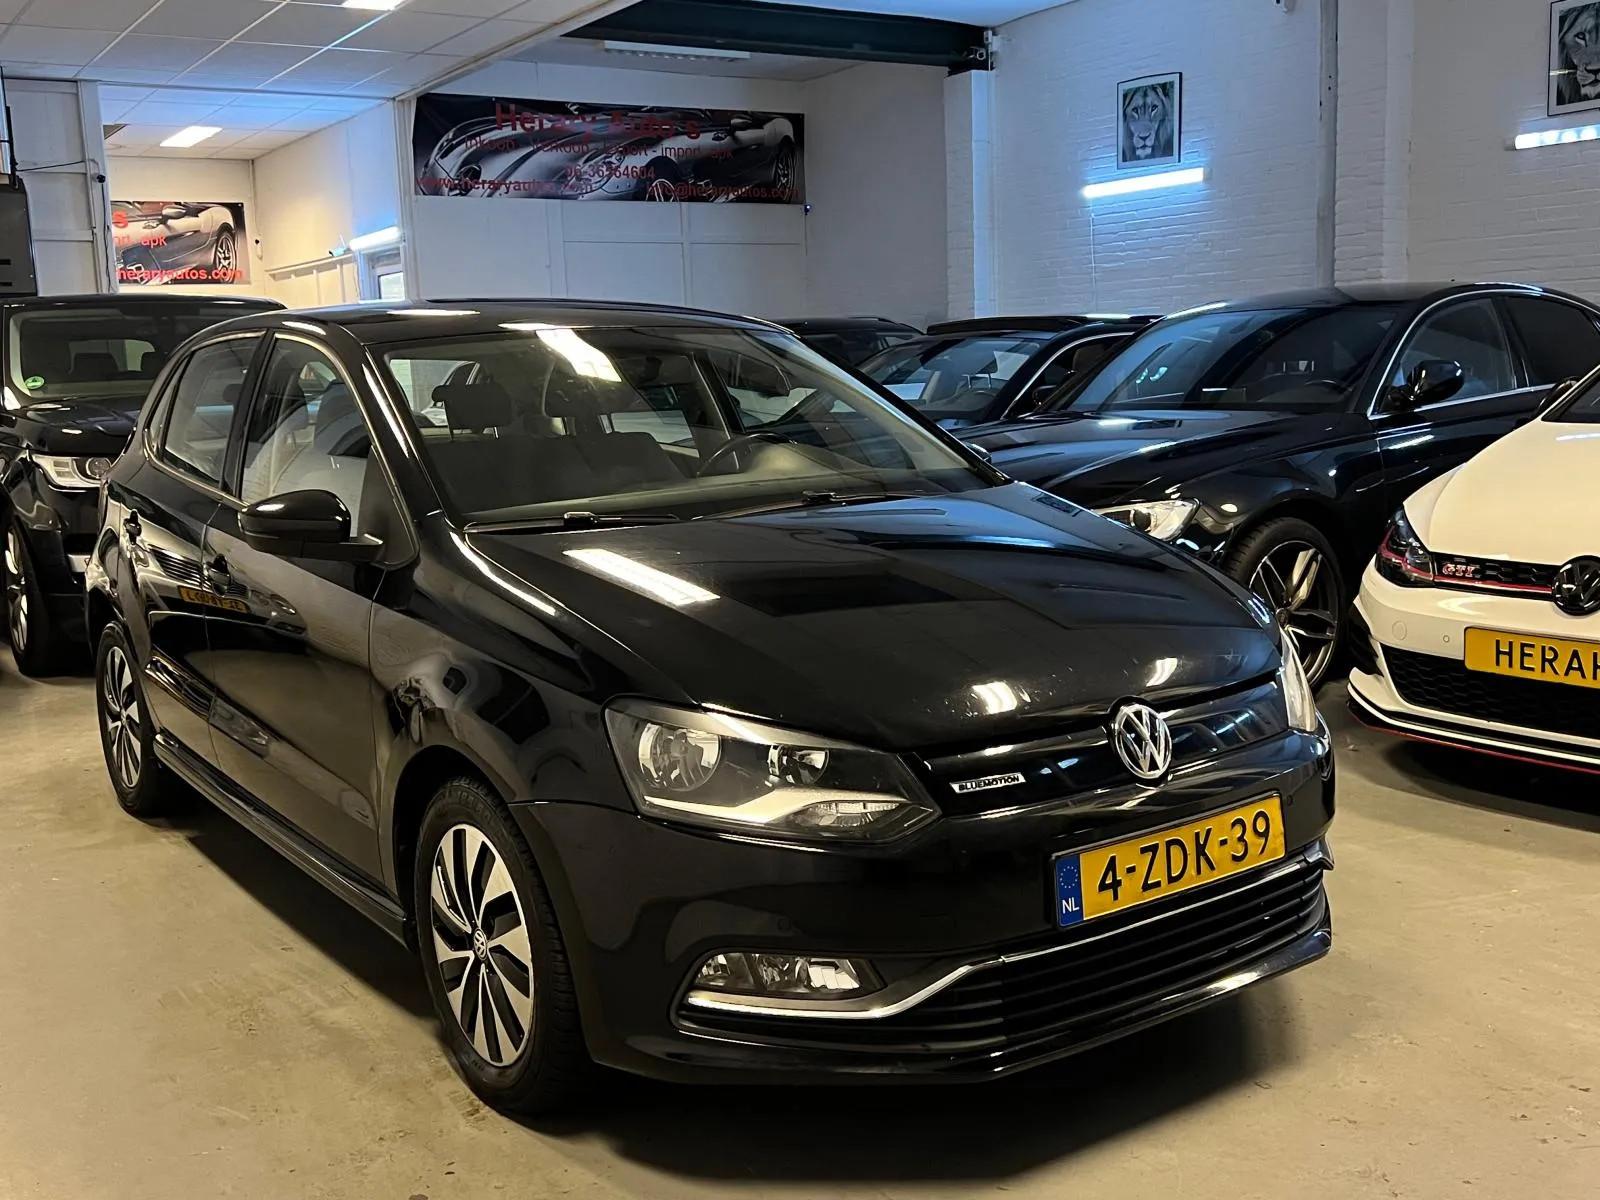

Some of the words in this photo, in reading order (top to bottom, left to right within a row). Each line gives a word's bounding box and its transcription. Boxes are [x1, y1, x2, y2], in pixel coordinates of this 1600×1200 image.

[141, 235, 167, 248] apk
[1442, 563, 1475, 578] GTI
[957, 774, 1020, 792] BLUEMOTION
[1097, 809, 1271, 902] 4-ZDK-39
[1061, 897, 1080, 914] NL
